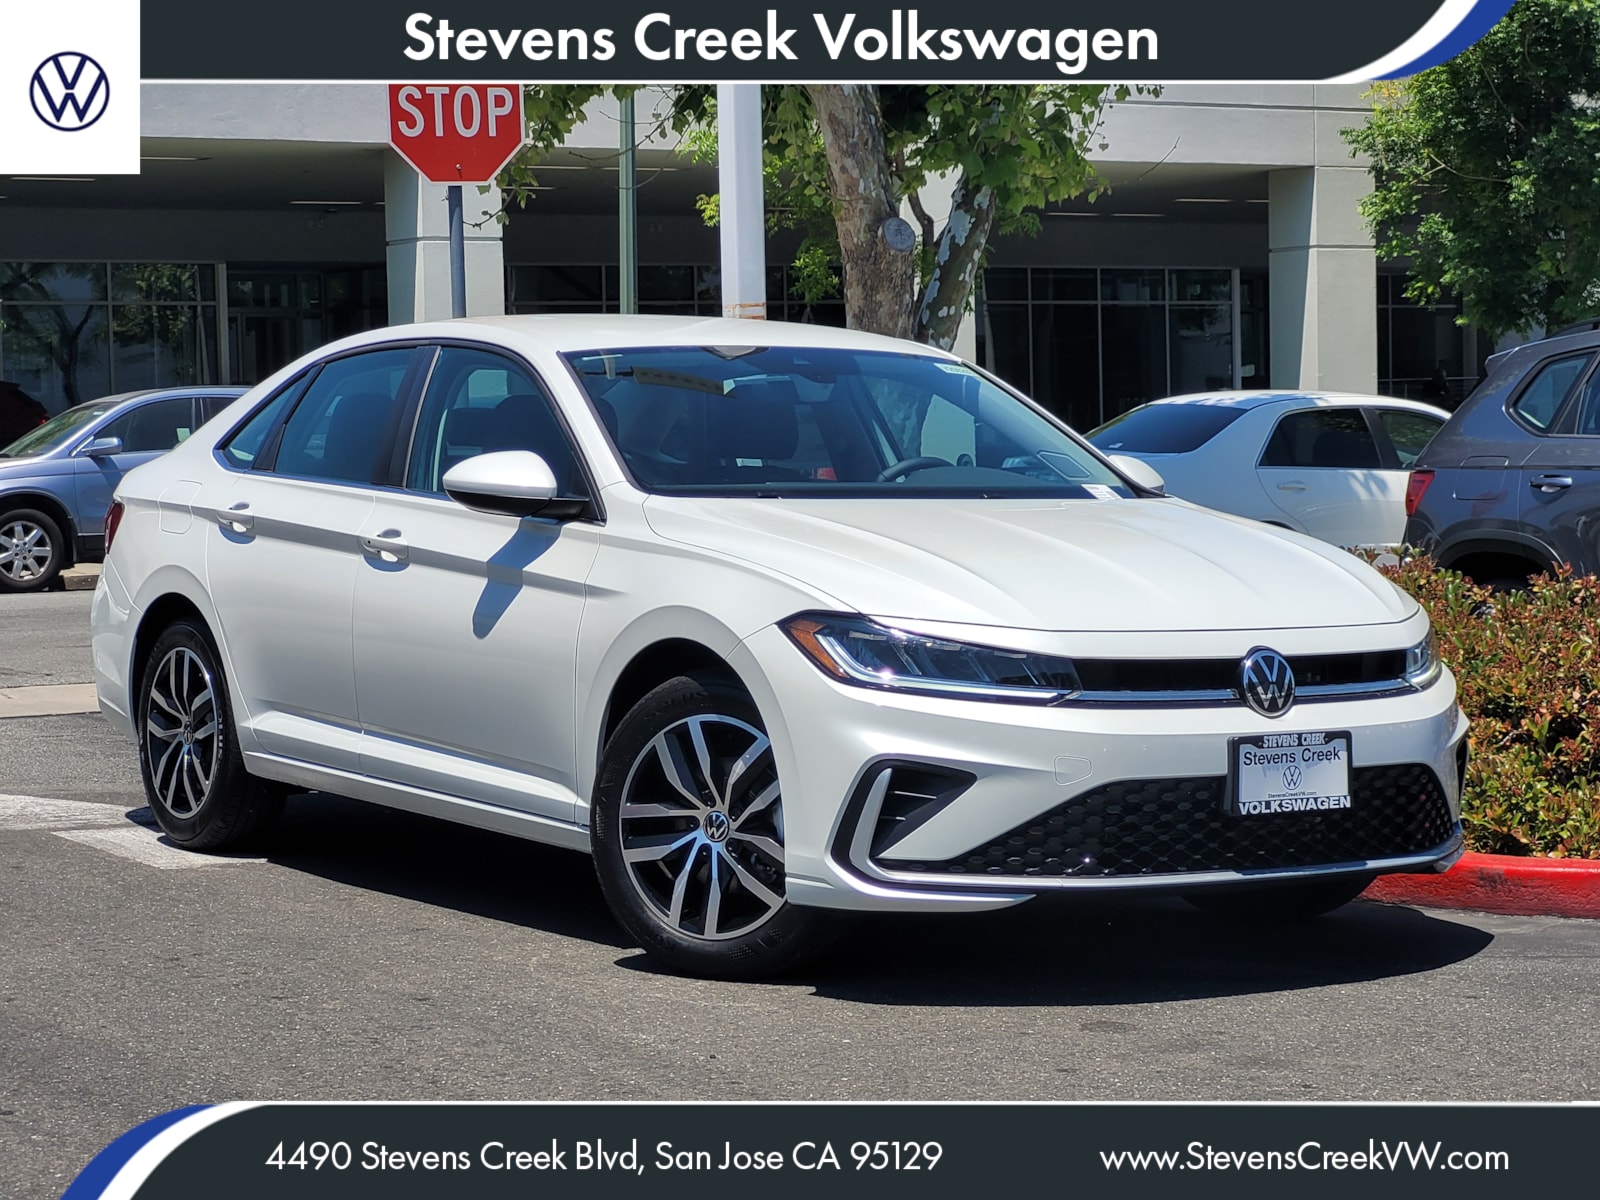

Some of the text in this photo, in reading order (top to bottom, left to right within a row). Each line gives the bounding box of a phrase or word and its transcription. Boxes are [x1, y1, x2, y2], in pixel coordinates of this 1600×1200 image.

[397, 86, 514, 138] STOP
[1263, 732, 1326, 748] STEVENS CREEK
[1243, 747, 1341, 766] Stevens Creek
[1239, 796, 1351, 815] VOLKSWAGEN
